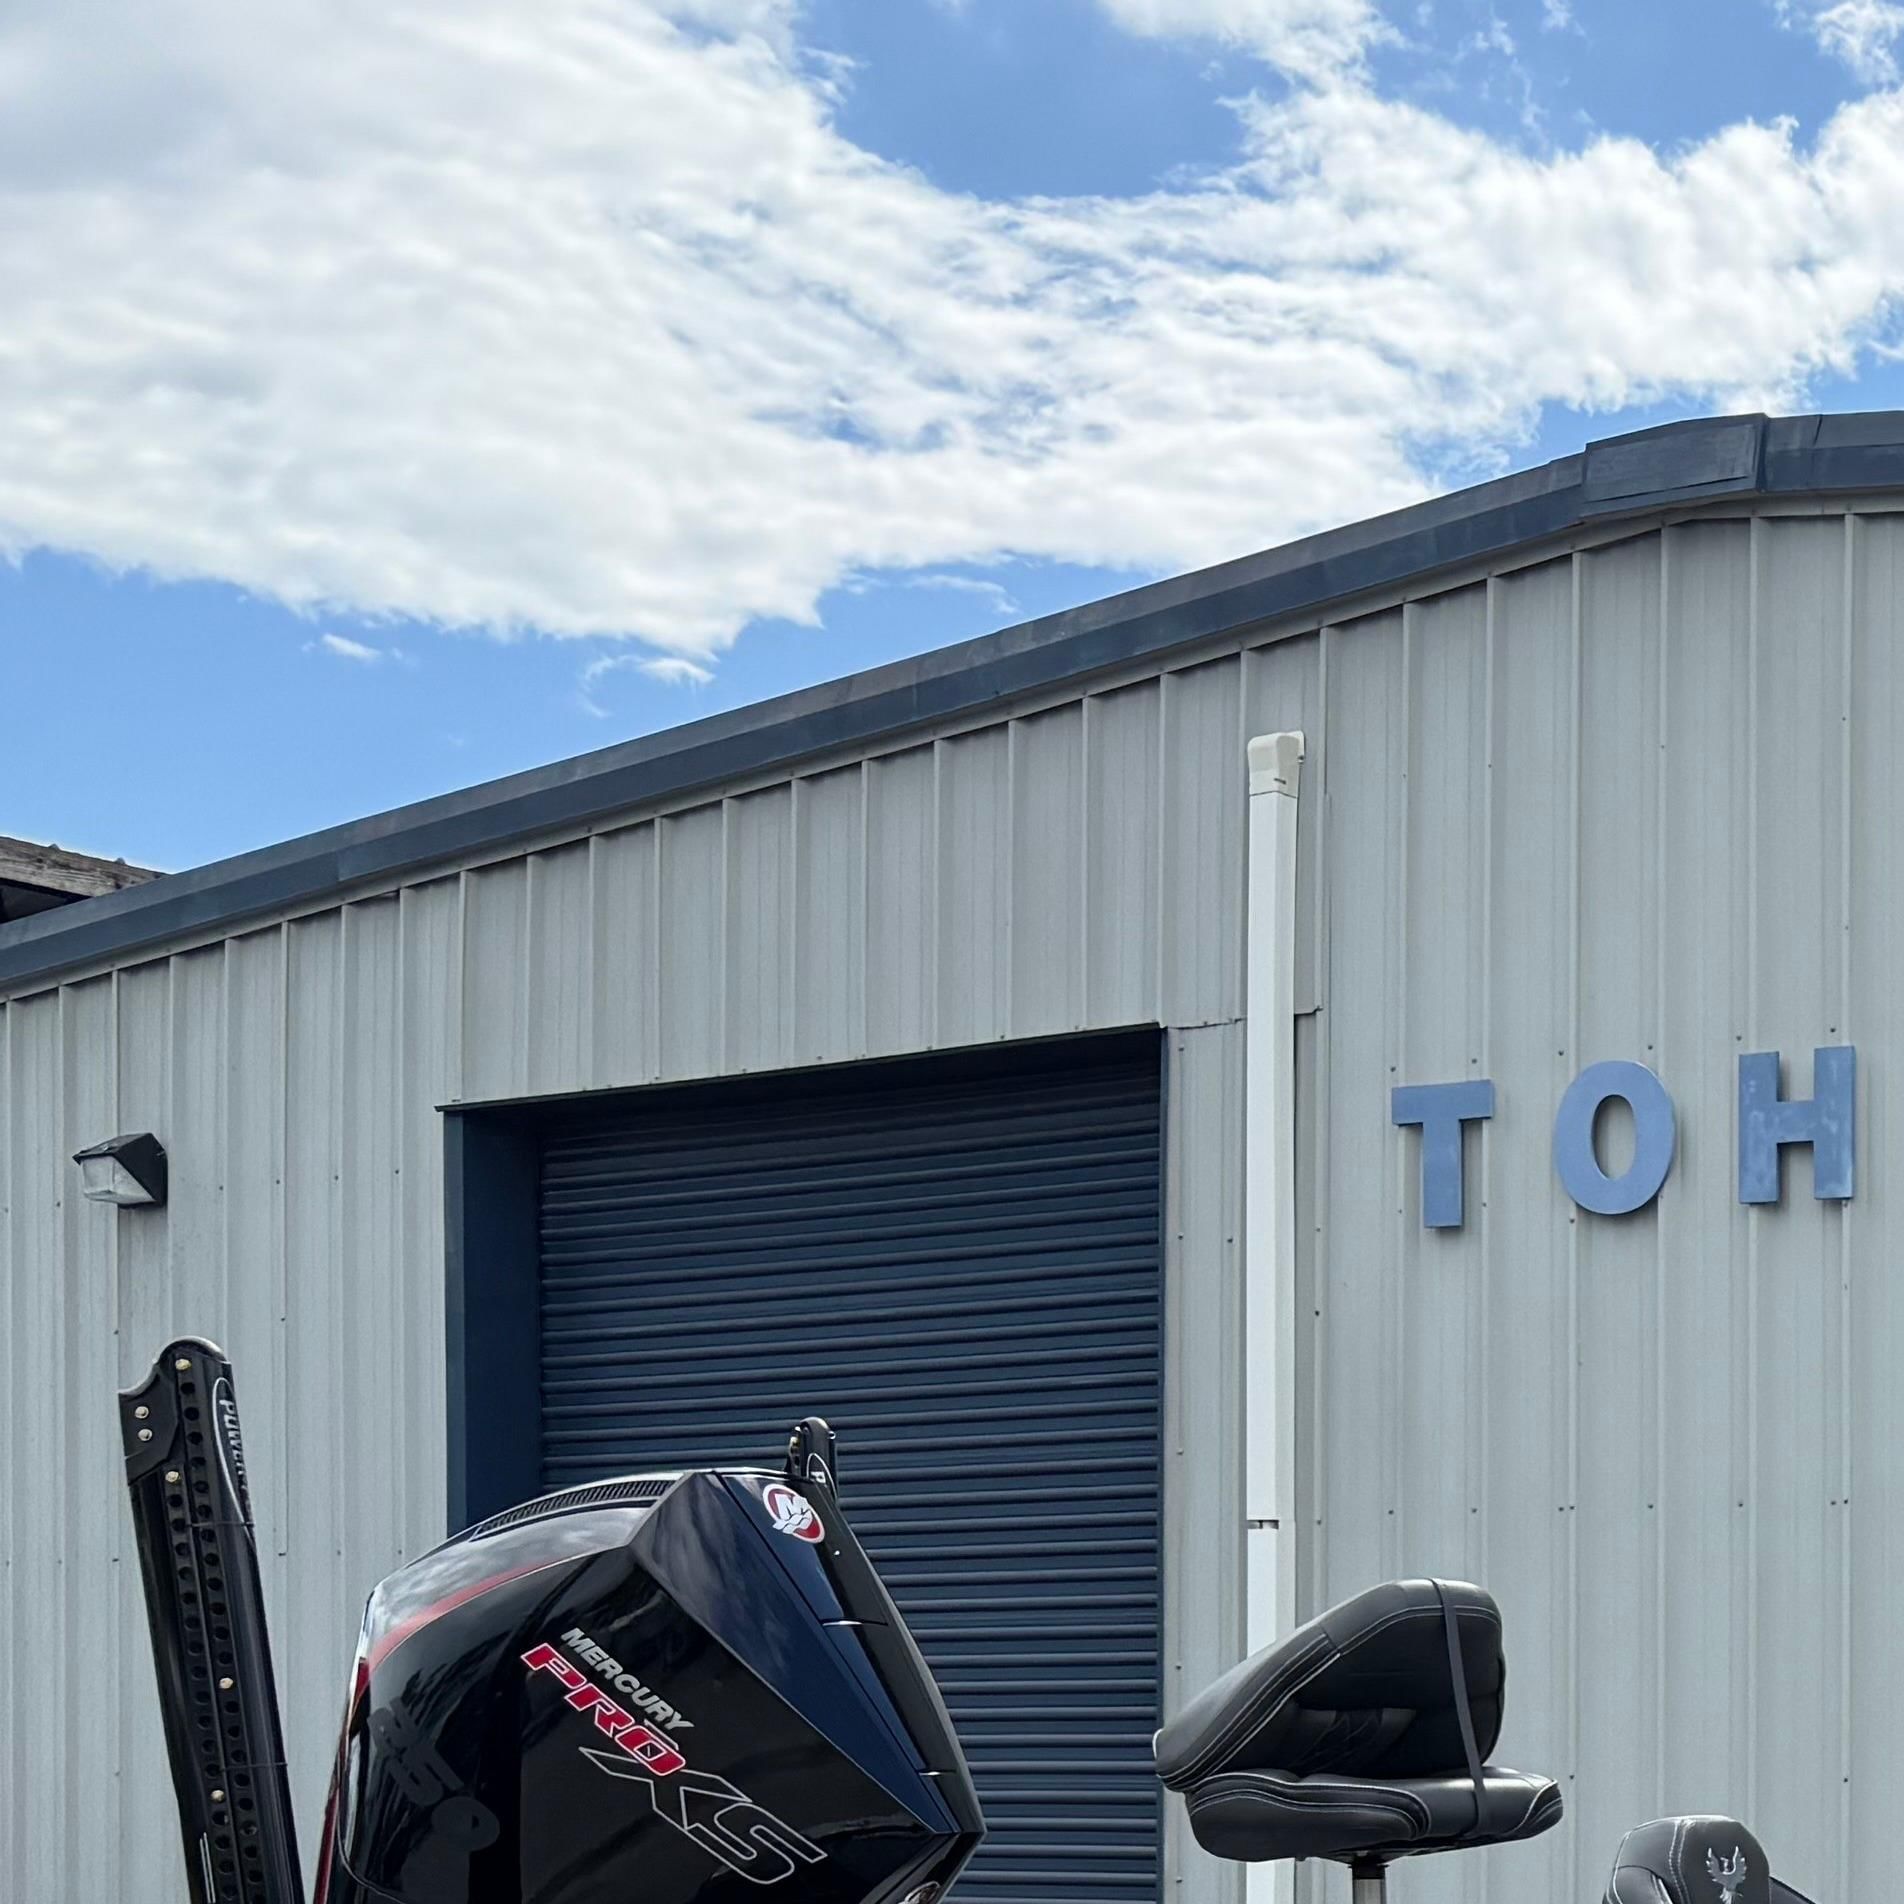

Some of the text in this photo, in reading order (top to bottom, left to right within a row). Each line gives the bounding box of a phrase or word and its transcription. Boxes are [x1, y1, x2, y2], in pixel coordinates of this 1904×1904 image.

[519, 1642, 687, 1777] PRO
[560, 1626, 695, 1732] MERCURY
[577, 1718, 828, 1884] XS
